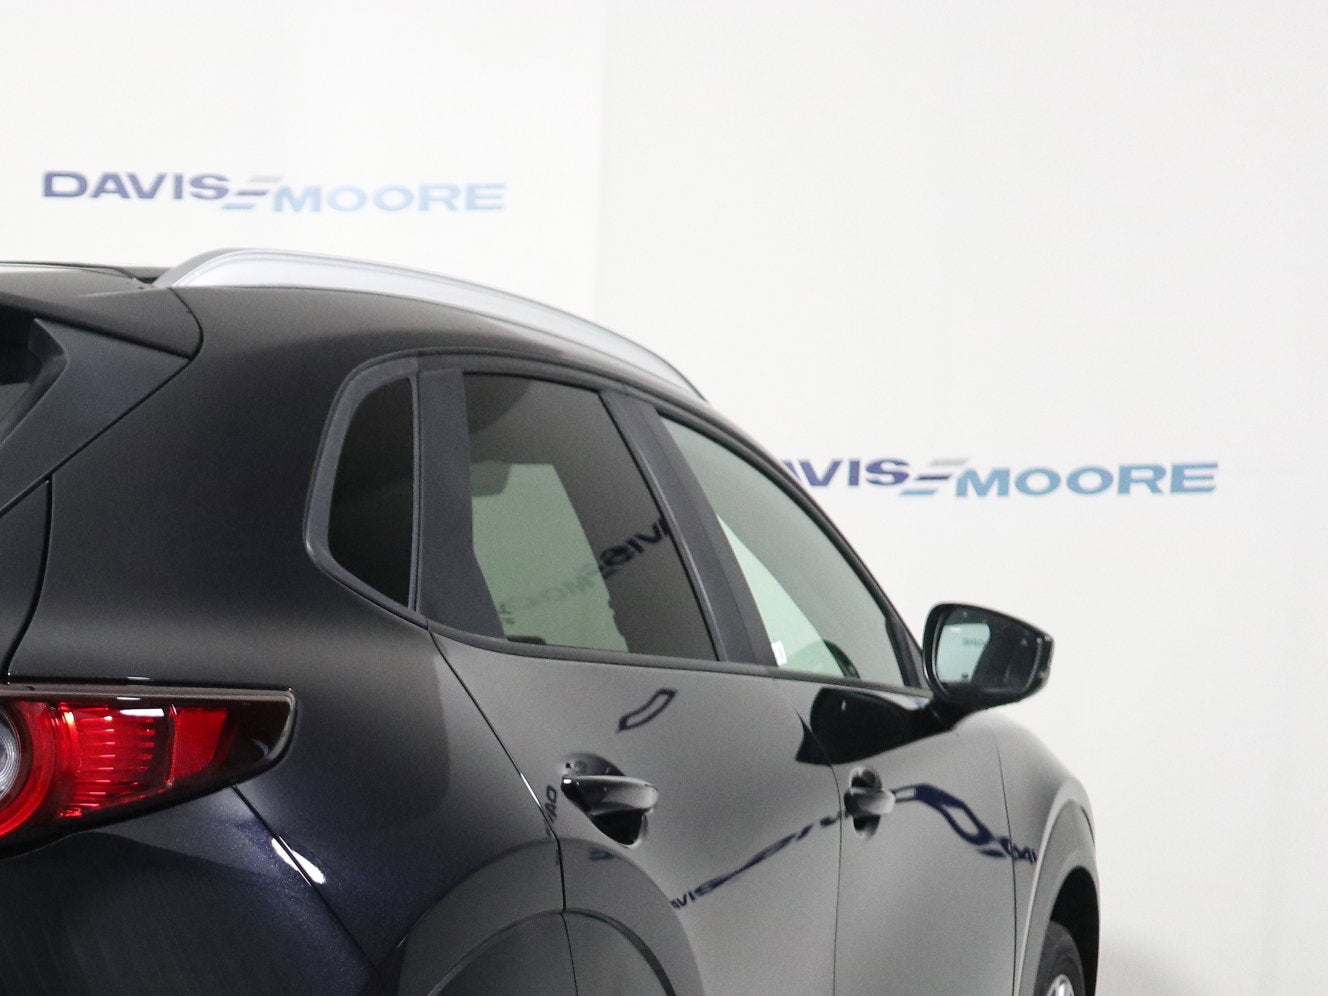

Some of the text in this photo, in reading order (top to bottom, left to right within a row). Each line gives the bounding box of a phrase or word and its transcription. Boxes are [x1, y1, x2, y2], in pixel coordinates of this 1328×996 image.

[42, 170, 507, 213] DAVIS MOORE
[955, 461, 1219, 498] MOORE
